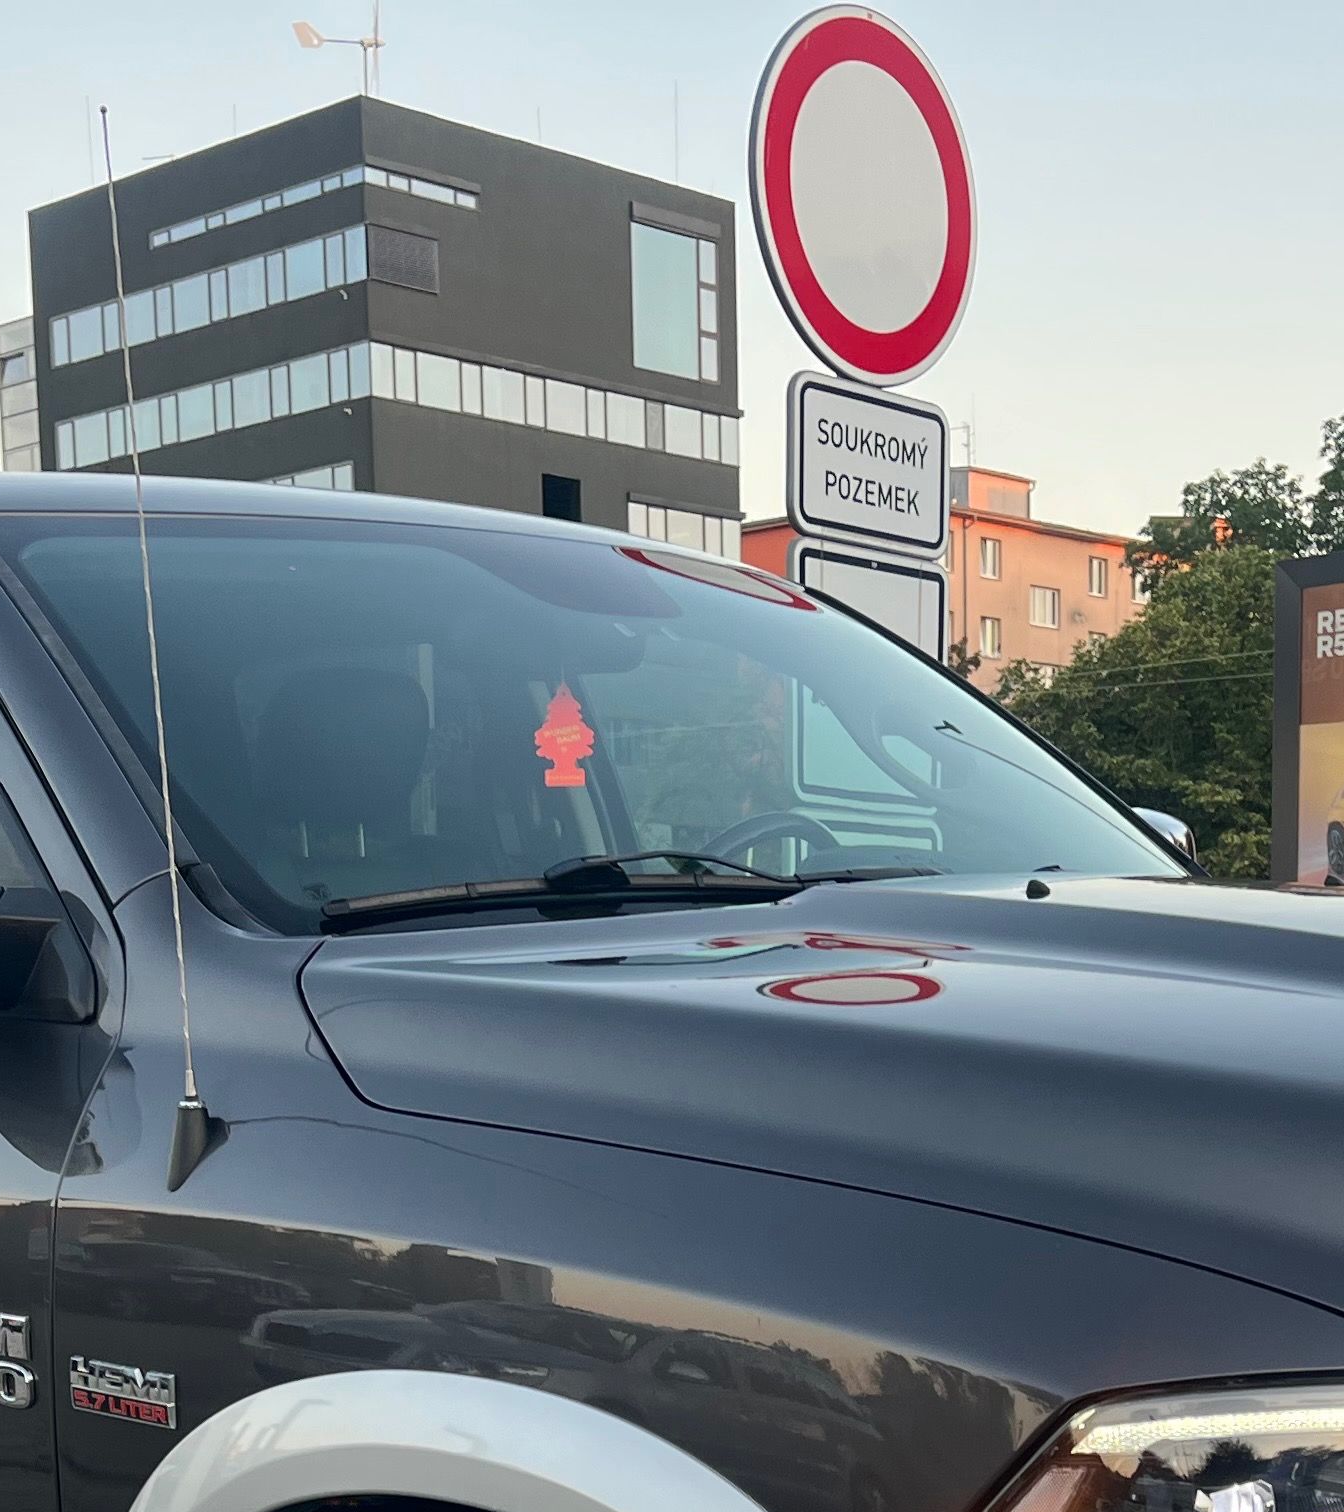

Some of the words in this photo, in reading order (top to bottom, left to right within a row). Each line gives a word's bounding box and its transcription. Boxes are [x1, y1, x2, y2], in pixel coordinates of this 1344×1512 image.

[818, 418, 928, 469] SOUKROMÝ
[825, 470, 920, 516] POZEMEK
[70, 1354, 175, 1406] HEMI
[73, 1389, 105, 1410] 5.7
[109, 1396, 168, 1424] LITER
